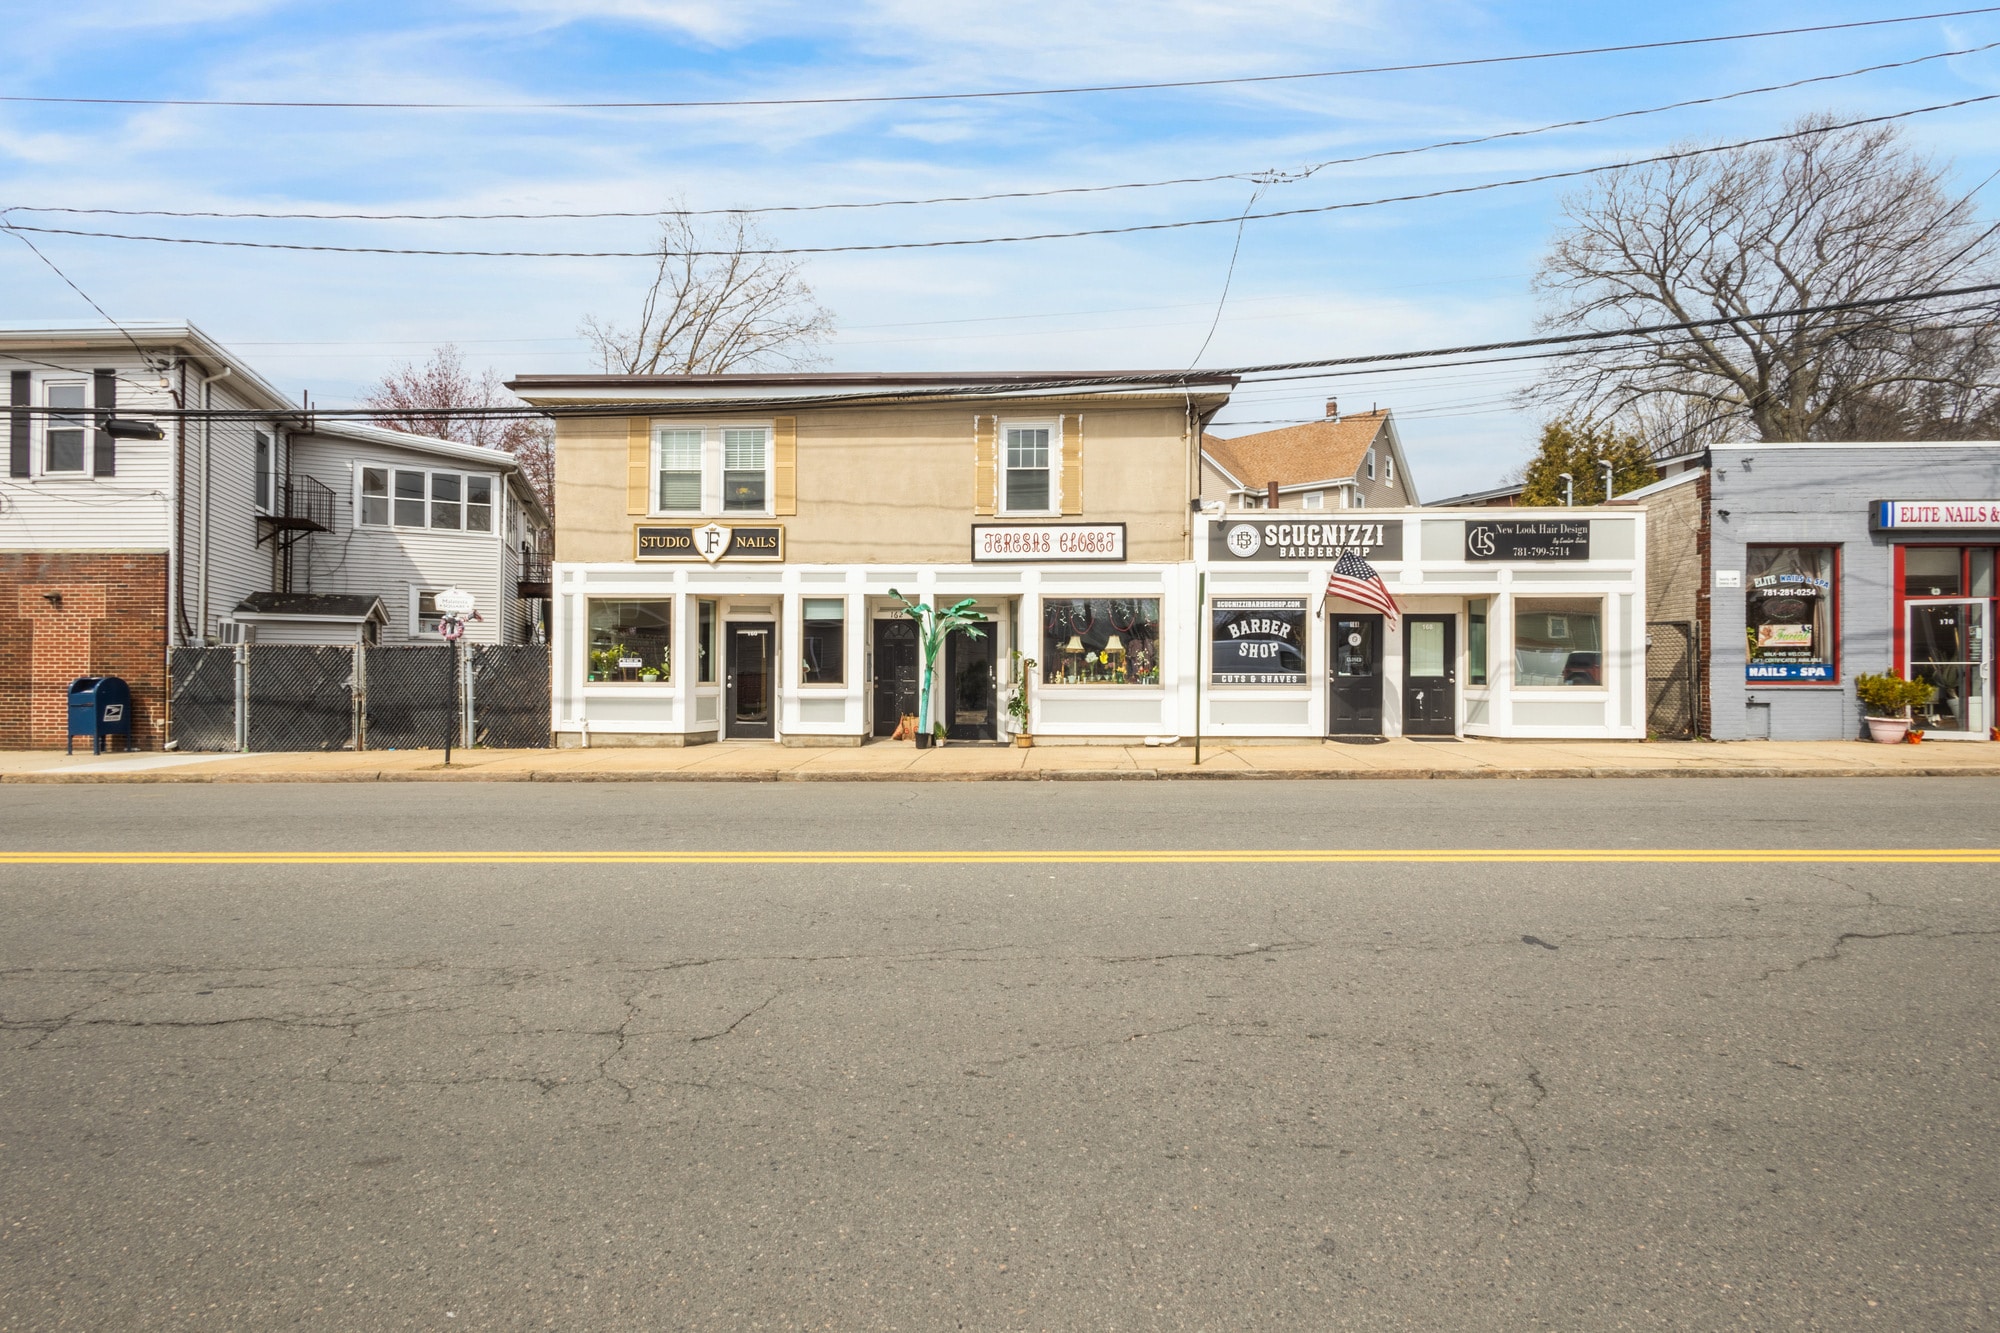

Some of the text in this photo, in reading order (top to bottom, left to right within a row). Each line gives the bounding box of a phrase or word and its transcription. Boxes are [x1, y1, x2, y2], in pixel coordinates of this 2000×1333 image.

[1900, 506, 2000, 523] ELITE NAILS &
[1264, 524, 1384, 546] SCUGNIZZI
[1495, 524, 1588, 537] New Look Hair Design
[640, 531, 776, 554] STUDIO F NAILS
[1512, 547, 1570, 557] 781-799-5714
[1754, 574, 1777, 588] ELITE
[1779, 574, 1805, 583] NAILS
[1814, 577, 1830, 590] SPA
[1762, 588, 1816, 597] 781-281-0254
[1228, 619, 1291, 639] BARBER
[1238, 642, 1279, 658] SHOP
[1221, 675, 1246, 683] CUTS
[1261, 675, 1297, 683] SHAVES
[1749, 667, 1787, 677] NAILS
[1800, 667, 1826, 677] SPA
